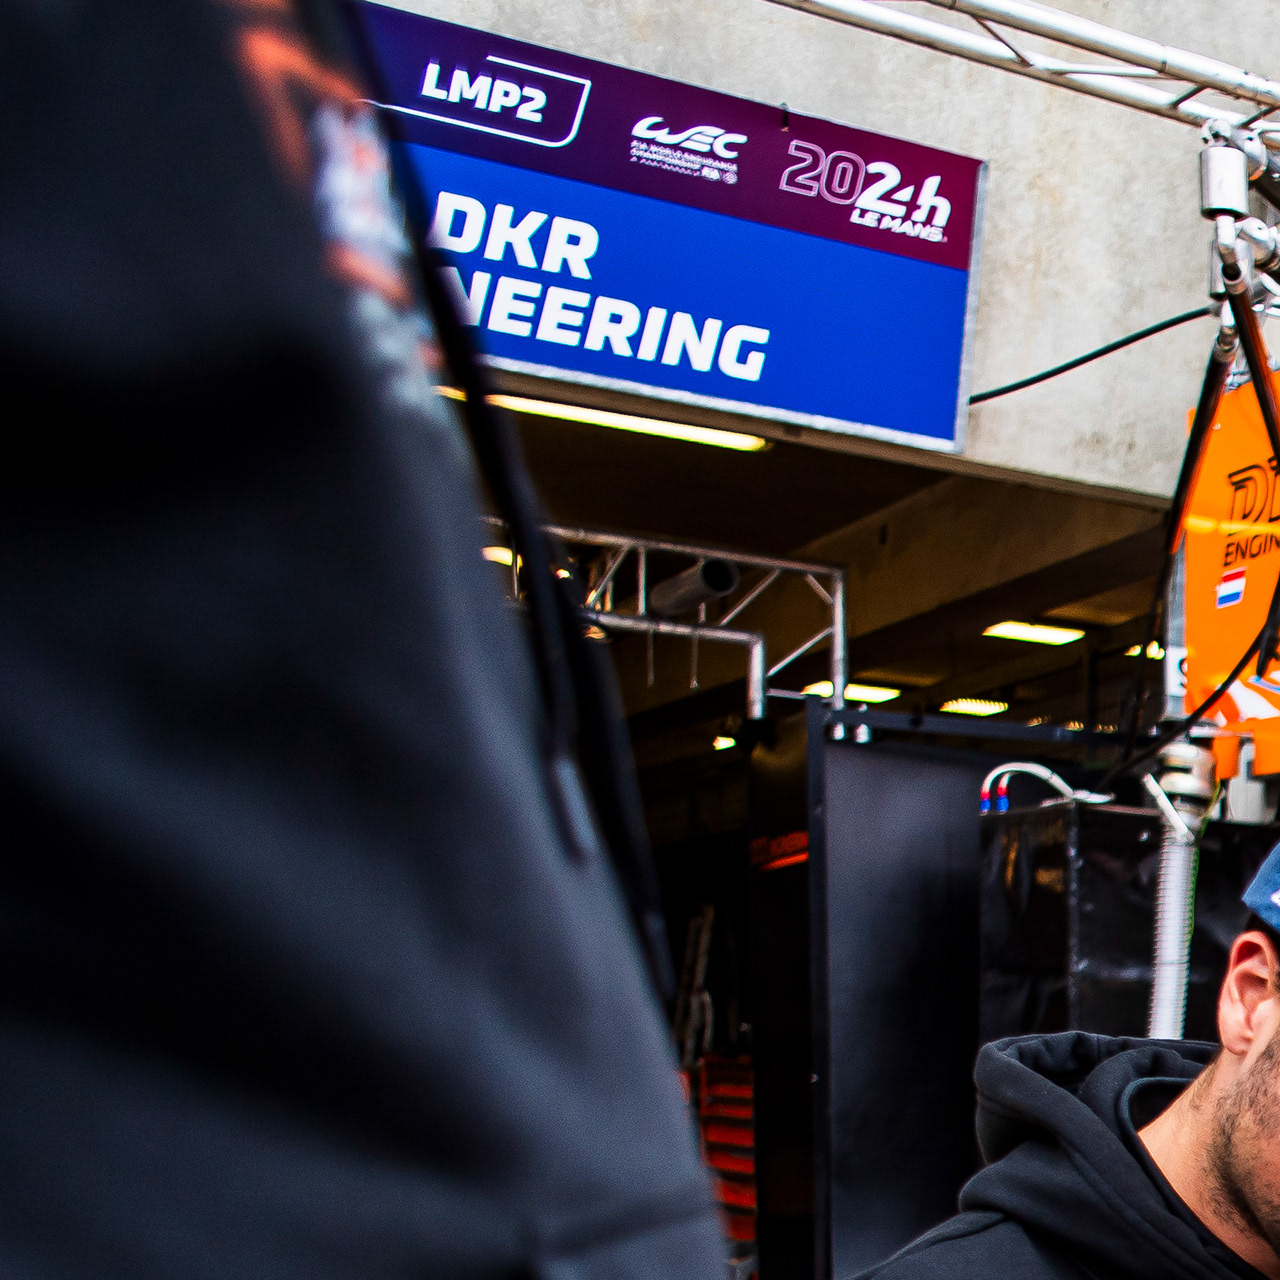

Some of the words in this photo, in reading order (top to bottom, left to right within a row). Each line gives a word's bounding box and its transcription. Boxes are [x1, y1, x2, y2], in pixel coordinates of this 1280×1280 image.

[421, 63, 548, 122] LMP2
[435, 191, 599, 280] DKR
[849, 208, 881, 228] LE
[878, 216, 946, 242] MANS
[447, 267, 770, 382] NEERING
